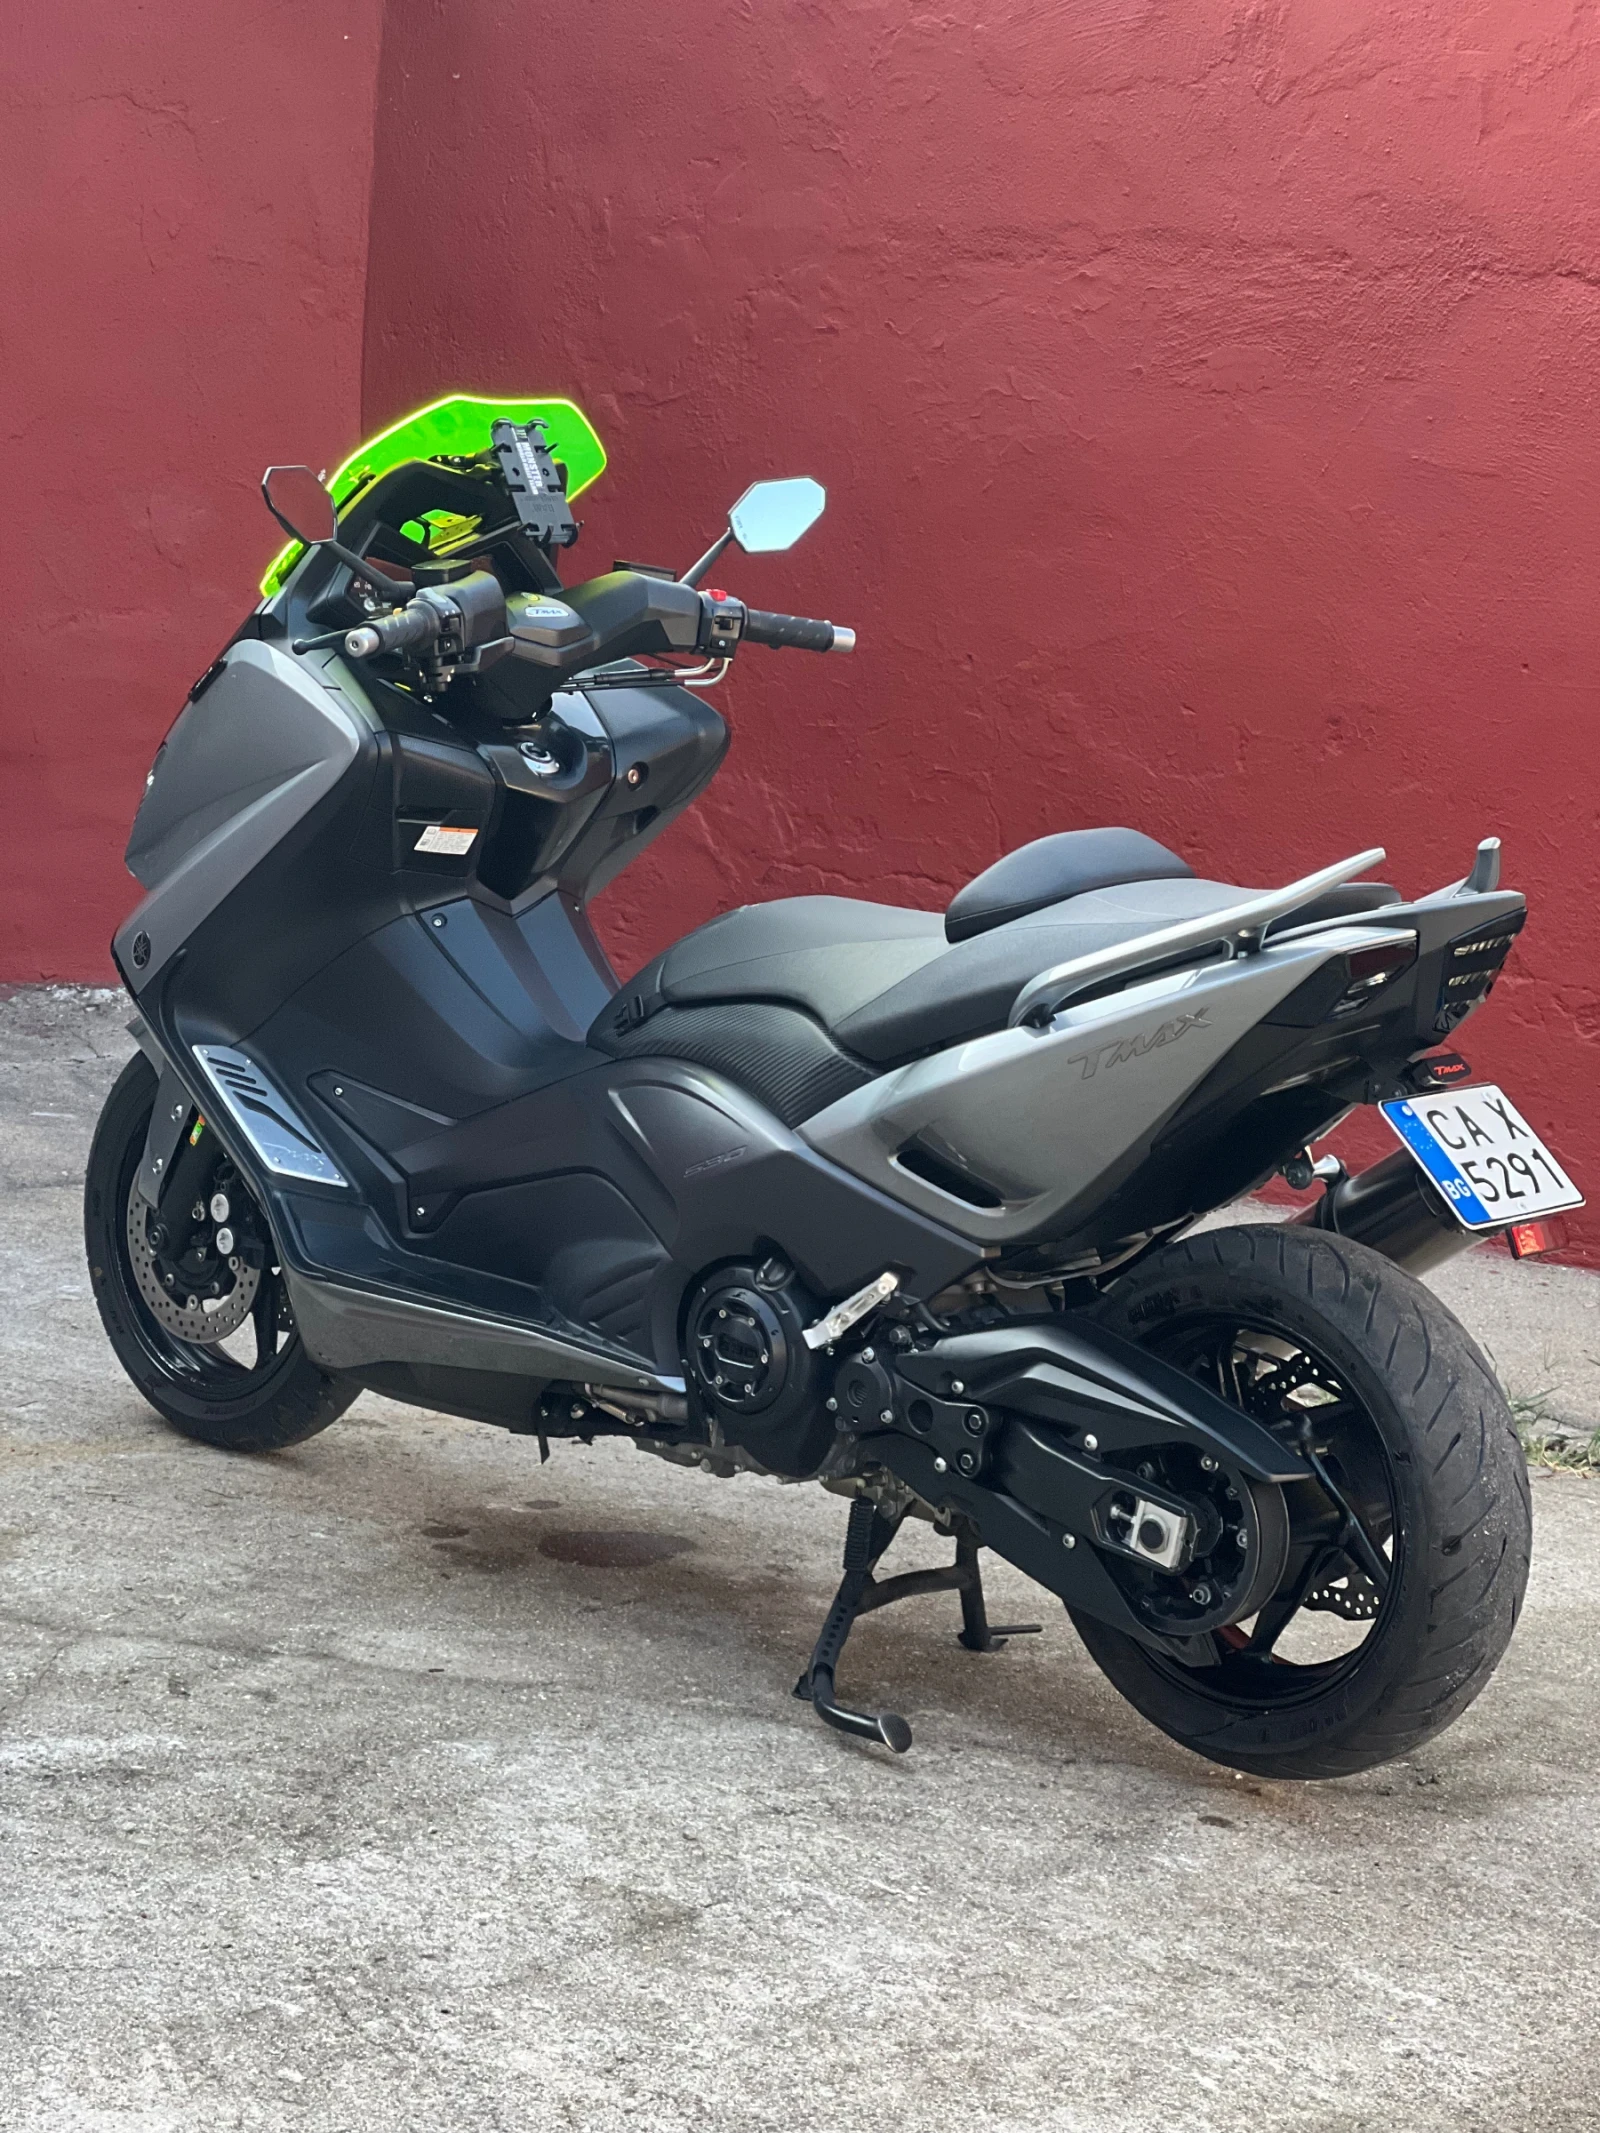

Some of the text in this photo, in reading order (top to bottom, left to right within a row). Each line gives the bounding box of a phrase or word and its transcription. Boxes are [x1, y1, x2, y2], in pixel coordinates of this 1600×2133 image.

[521, 442, 543, 487] MONSTER
[1427, 1098, 1530, 1150] CA X
[1441, 1178, 1471, 1200] BG
[1460, 1148, 1565, 1203] 5291
